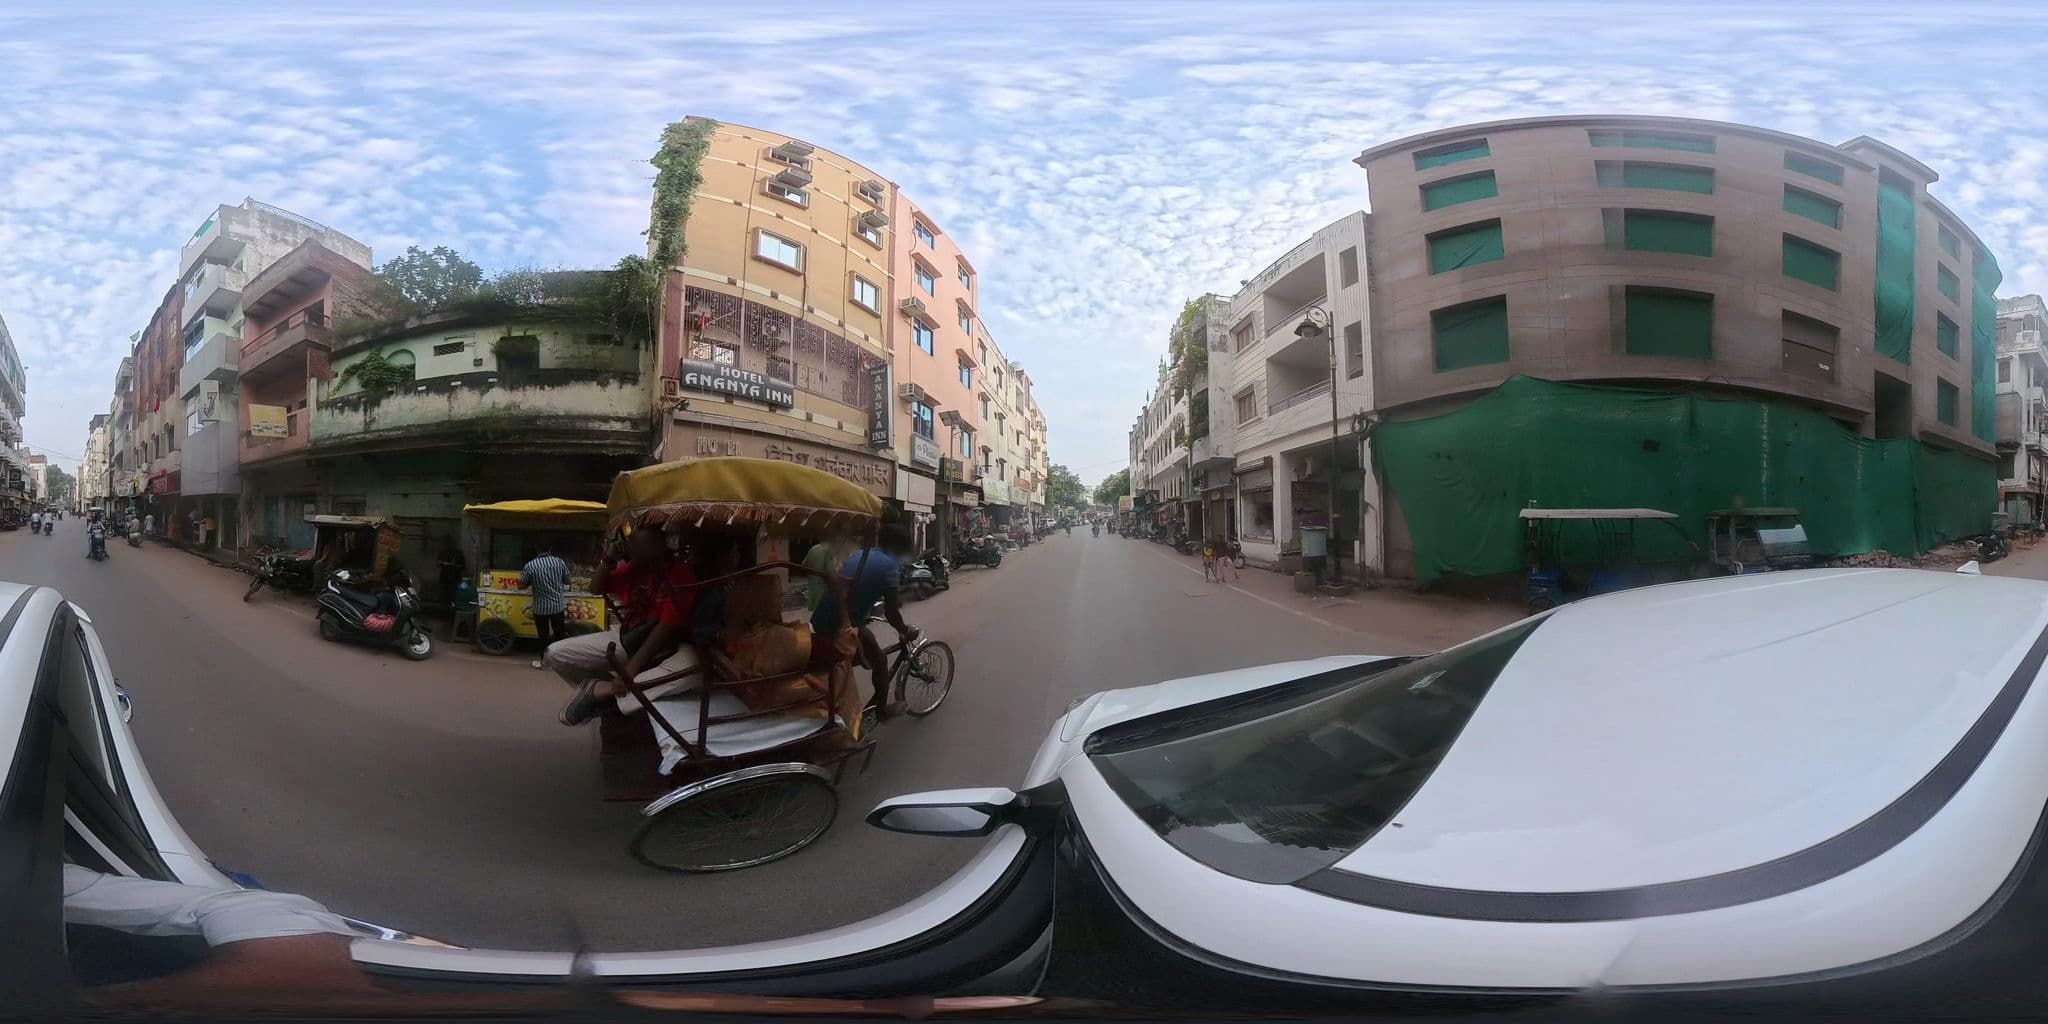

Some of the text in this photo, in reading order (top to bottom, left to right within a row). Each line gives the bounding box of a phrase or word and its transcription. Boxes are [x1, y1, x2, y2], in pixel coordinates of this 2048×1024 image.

[721, 366, 764, 385] HOTEL
[685, 373, 792, 405] ANANYA INN
[872, 431, 887, 441] INN
